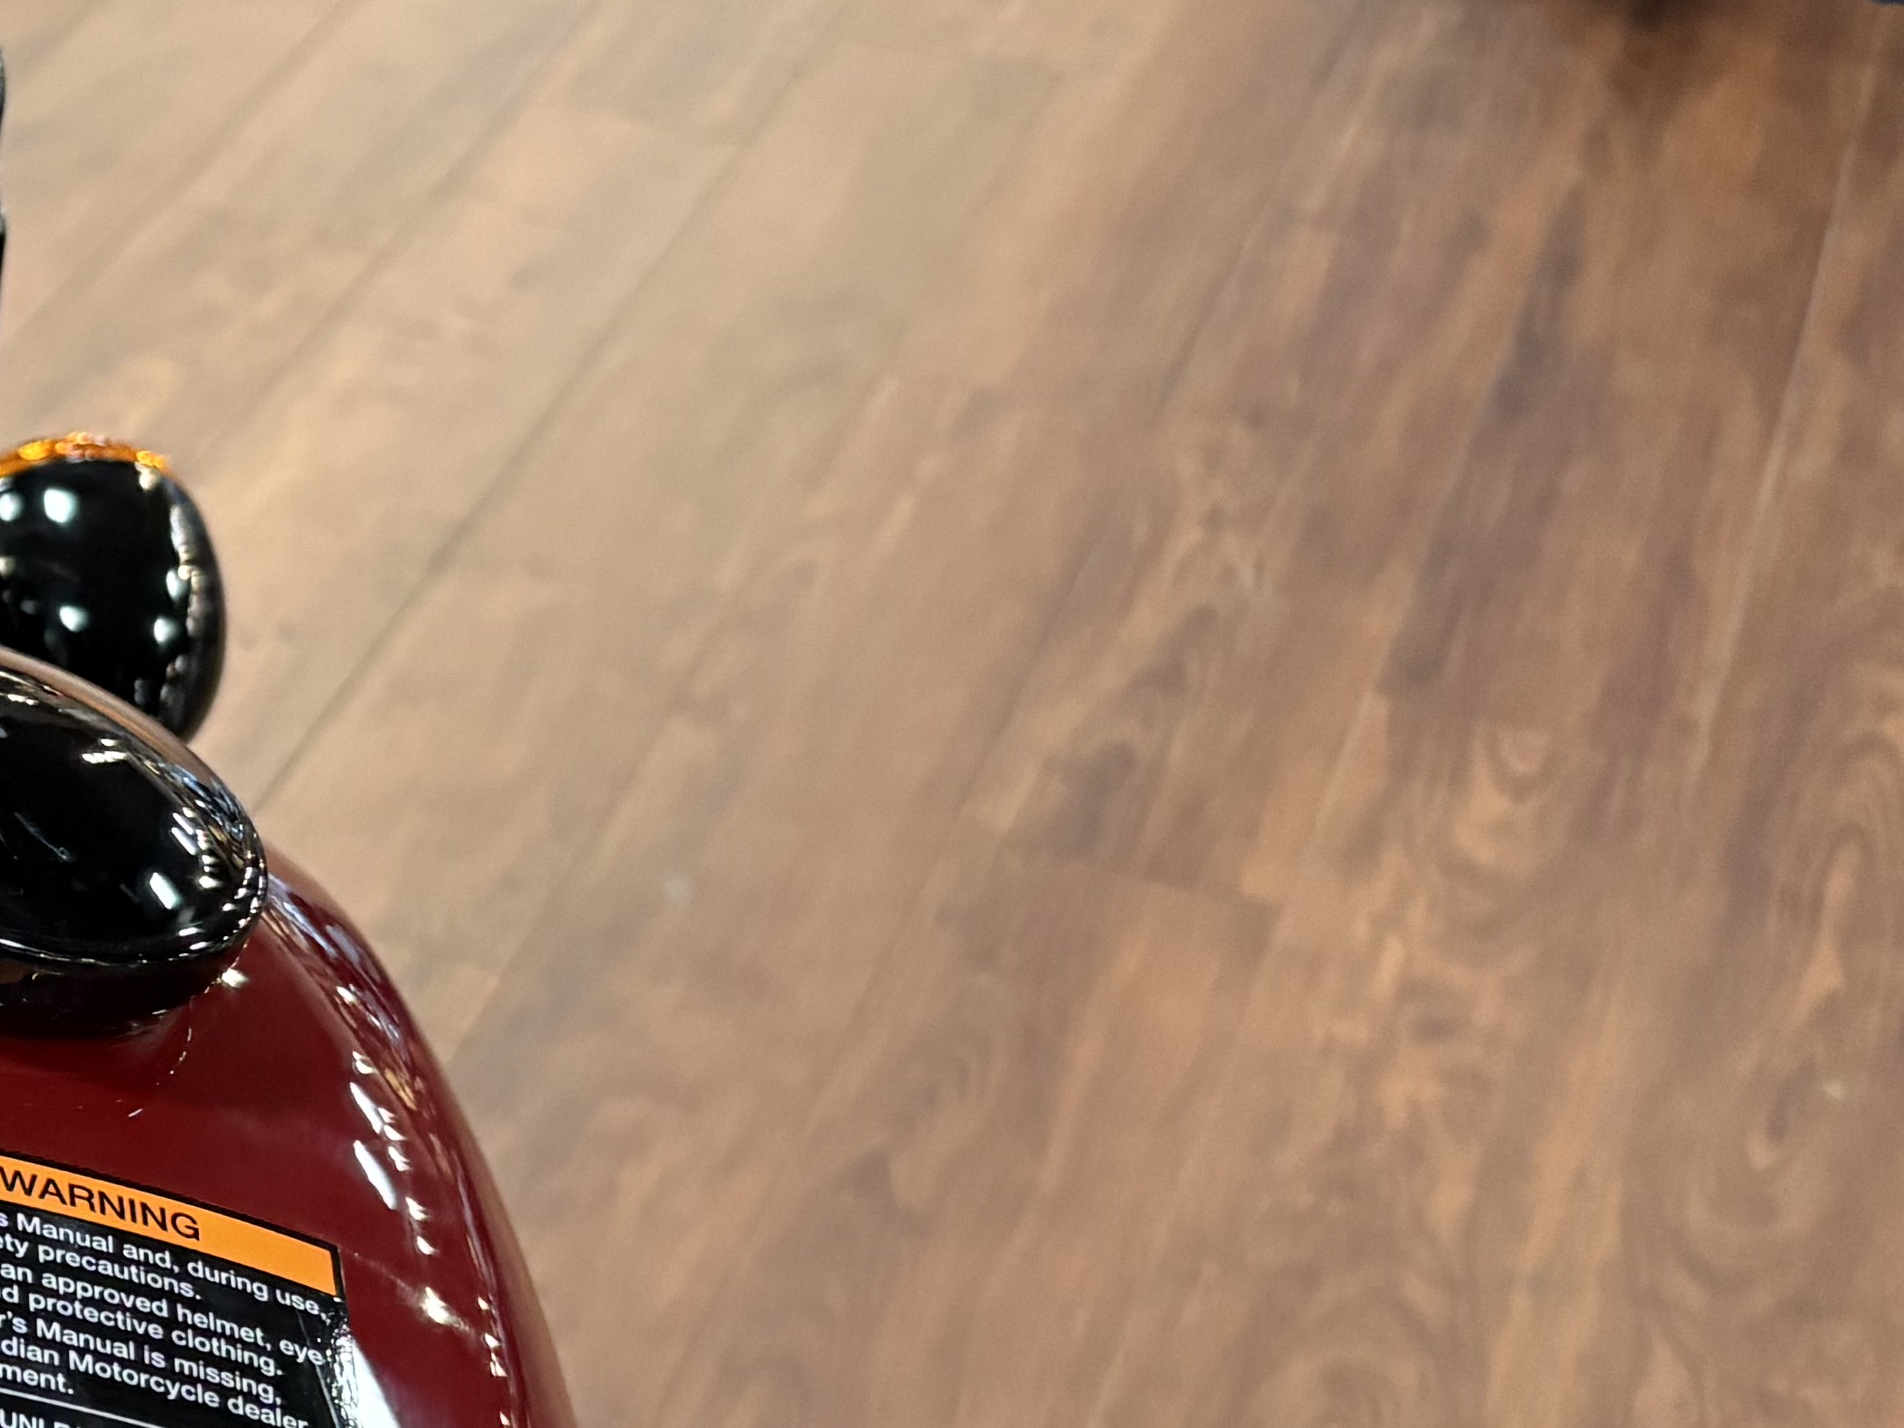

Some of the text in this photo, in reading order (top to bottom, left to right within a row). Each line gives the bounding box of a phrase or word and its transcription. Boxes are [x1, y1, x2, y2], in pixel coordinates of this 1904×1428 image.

[16, 1213, 113, 1254] Manual
[123, 1242, 179, 1273] and,
[188, 1260, 269, 1301] during
[276, 1288, 328, 1321] use,
[38, 1244, 202, 1300] precautions.
[0, 1261, 33, 1283] an
[42, 1274, 168, 1318] approved
[177, 1303, 272, 1350] helmet,
[279, 1339, 326, 1365] eye
[28, 1293, 163, 1339] protective
[172, 1329, 282, 1376] clothing.
[36, 1318, 135, 1360] Manual
[144, 1345, 166, 1368] is
[174, 1357, 282, 1405] missing,
[69, 1351, 220, 1408] Motorcycle
